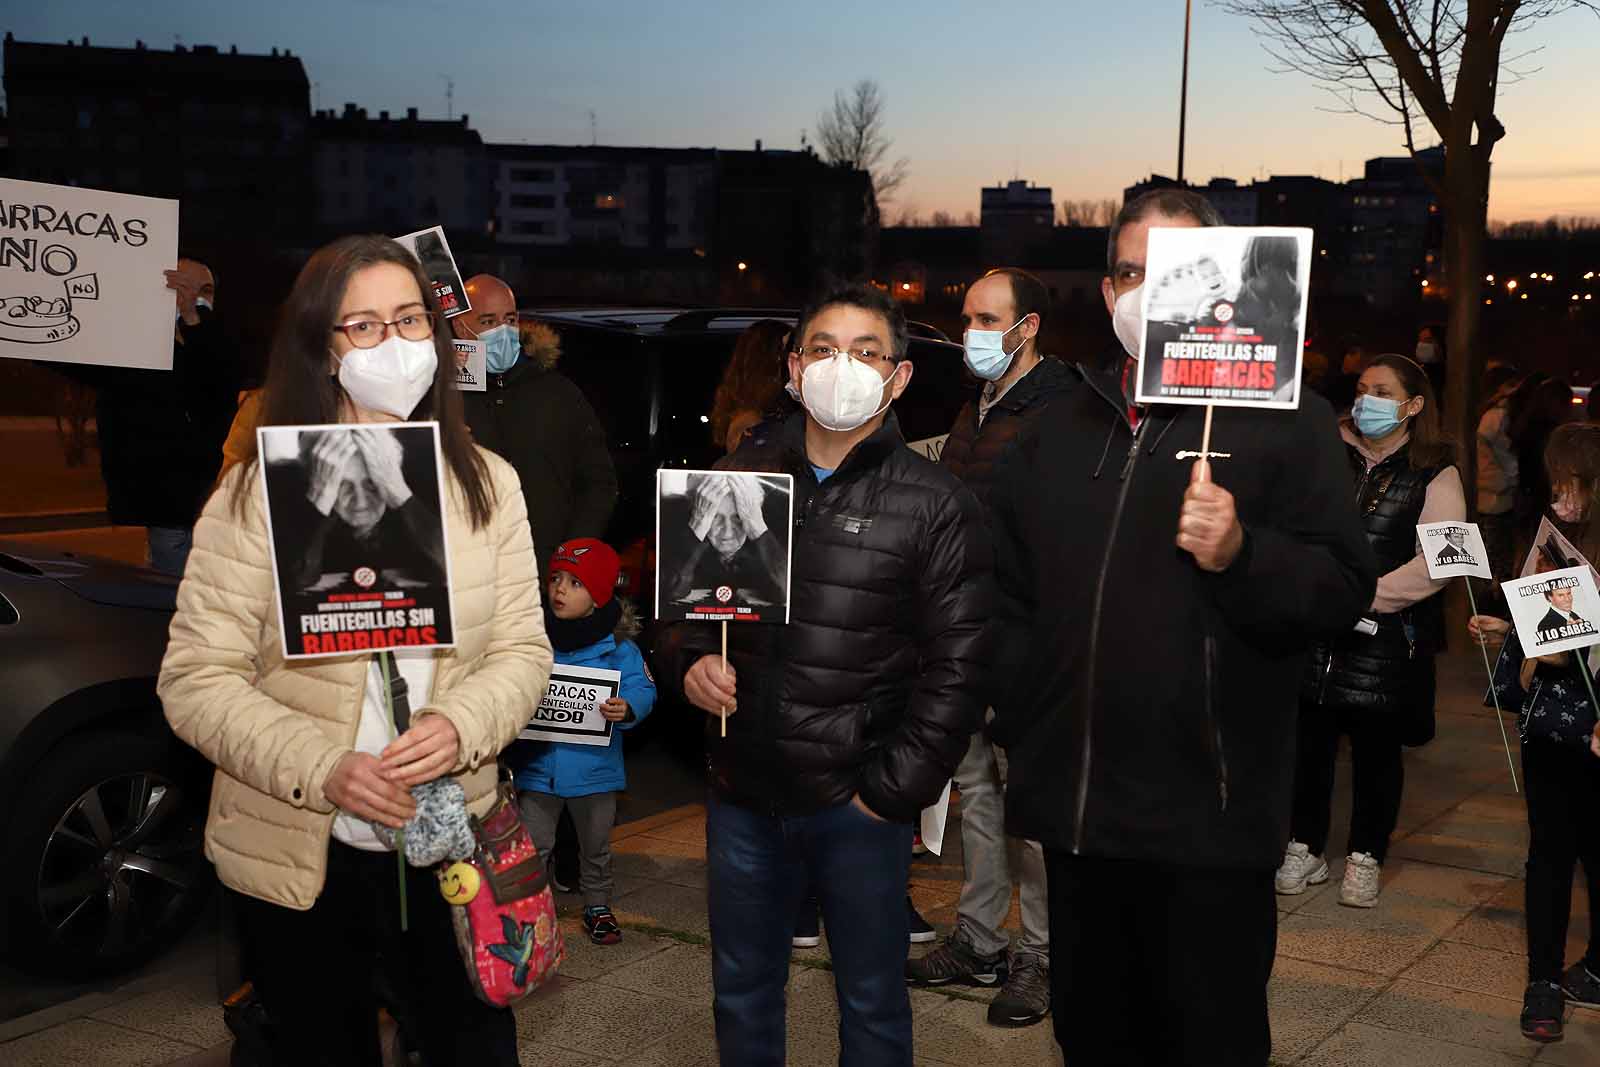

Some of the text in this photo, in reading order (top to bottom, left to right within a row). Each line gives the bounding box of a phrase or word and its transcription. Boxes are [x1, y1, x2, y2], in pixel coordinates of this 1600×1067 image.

[0, 237, 77, 276] NO
[72, 283, 94, 294] NO
[1164, 341, 1277, 361] FUENTECILLAS SIN
[1161, 358, 1276, 389] BARRACAS
[1435, 557, 1442, 565] Y
[1442, 556, 1453, 564] LO
[1519, 576, 1580, 598] NO SON 2 AÑOS
[300, 607, 436, 633] FUENTECILLAS SIN
[303, 626, 438, 655] BARRACAS
[1535, 629, 1546, 643] Y
[1545, 627, 1560, 641] LO
[545, 684, 597, 701] RACAS
